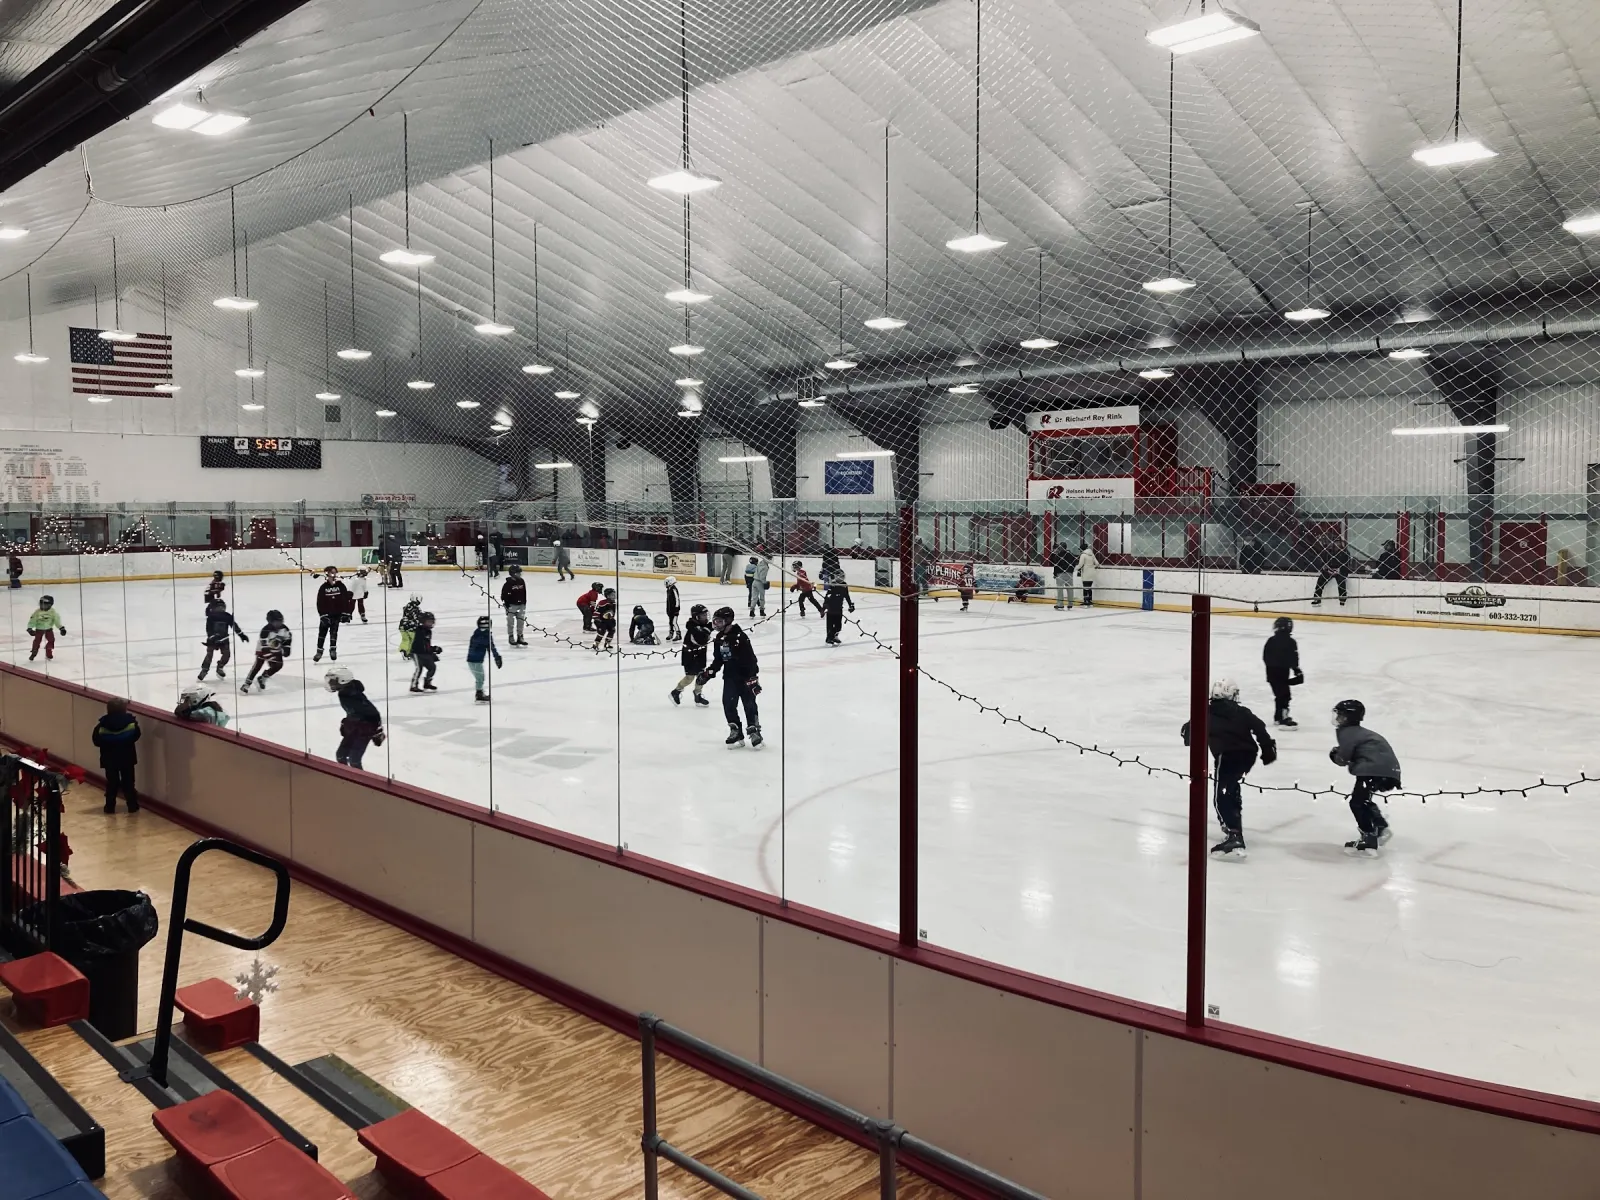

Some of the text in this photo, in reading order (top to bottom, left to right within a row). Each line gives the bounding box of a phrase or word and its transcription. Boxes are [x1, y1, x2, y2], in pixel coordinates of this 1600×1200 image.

[1092, 414, 1105, 422] Roy
[1086, 487, 1114, 495] Hutchings
[1489, 612, 1537, 622] 603-332-3270
